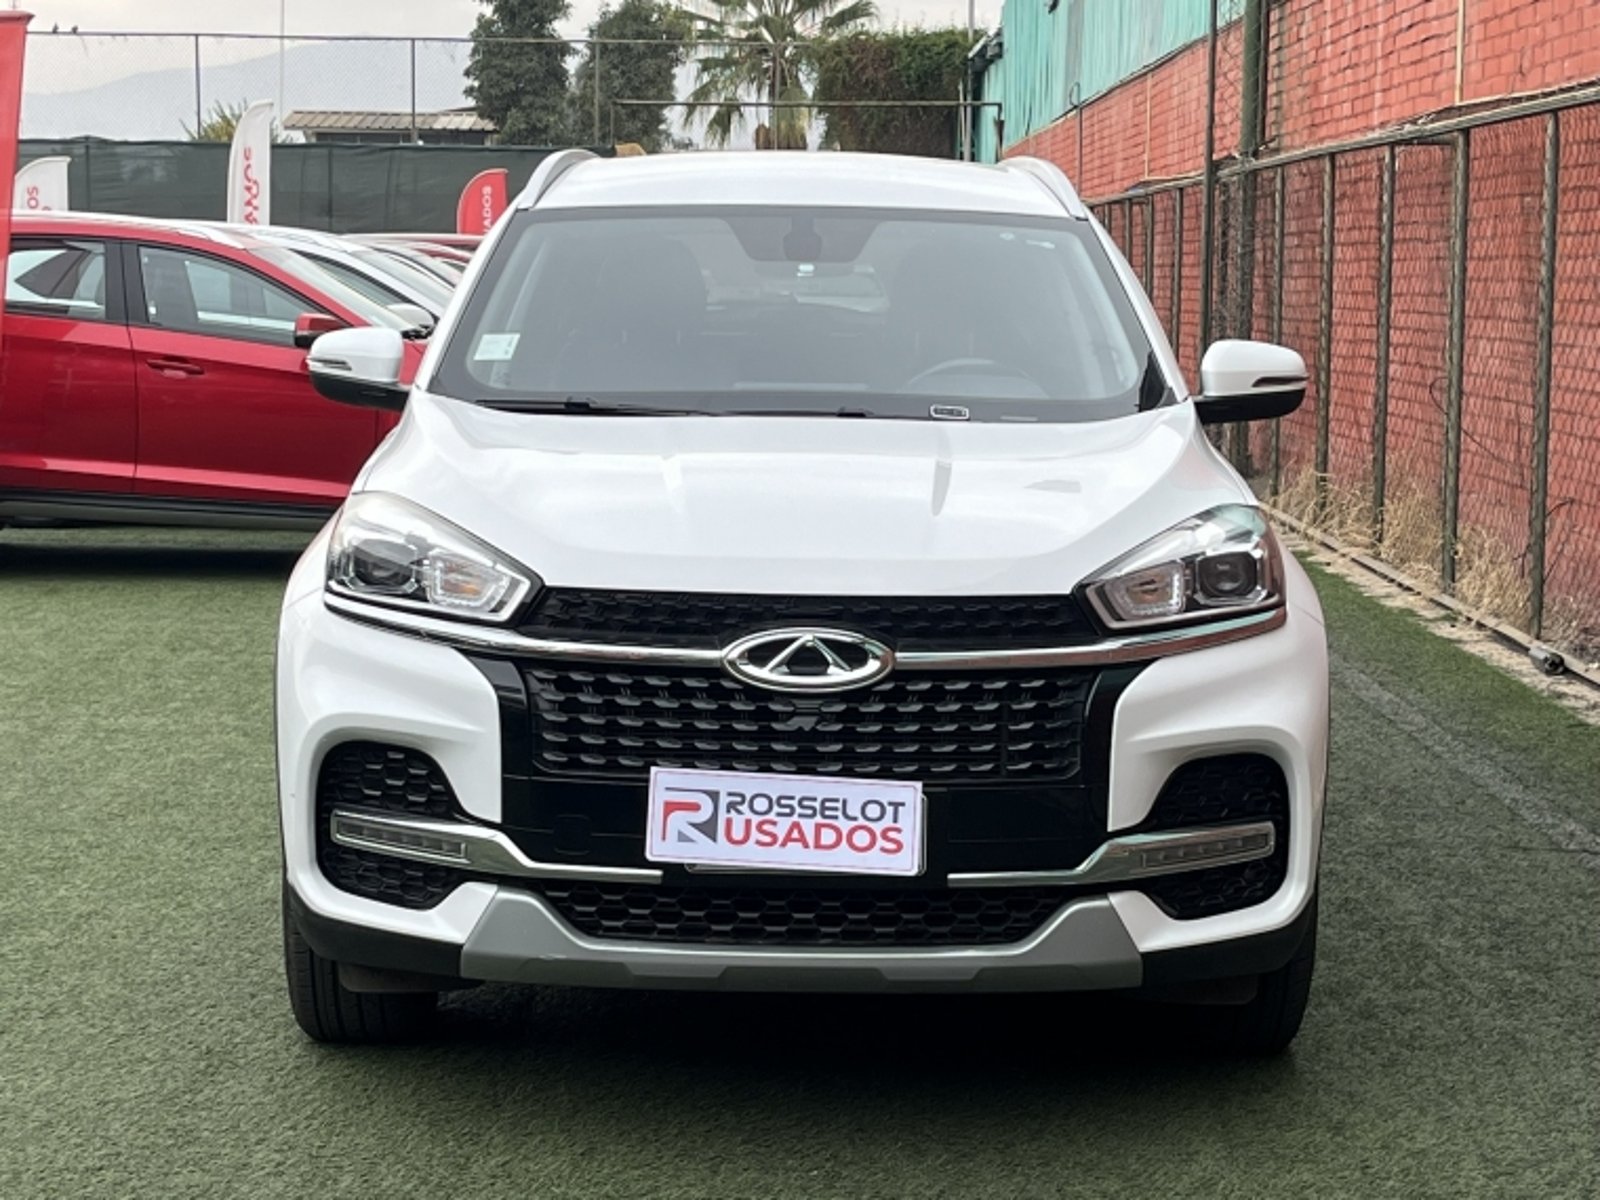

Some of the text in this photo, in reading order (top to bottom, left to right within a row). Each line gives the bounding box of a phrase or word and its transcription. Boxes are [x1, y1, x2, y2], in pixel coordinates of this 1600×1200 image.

[482, 185, 492, 232] ADOS
[725, 791, 906, 824] ROSSELOT
[723, 817, 904, 855] USADOS
